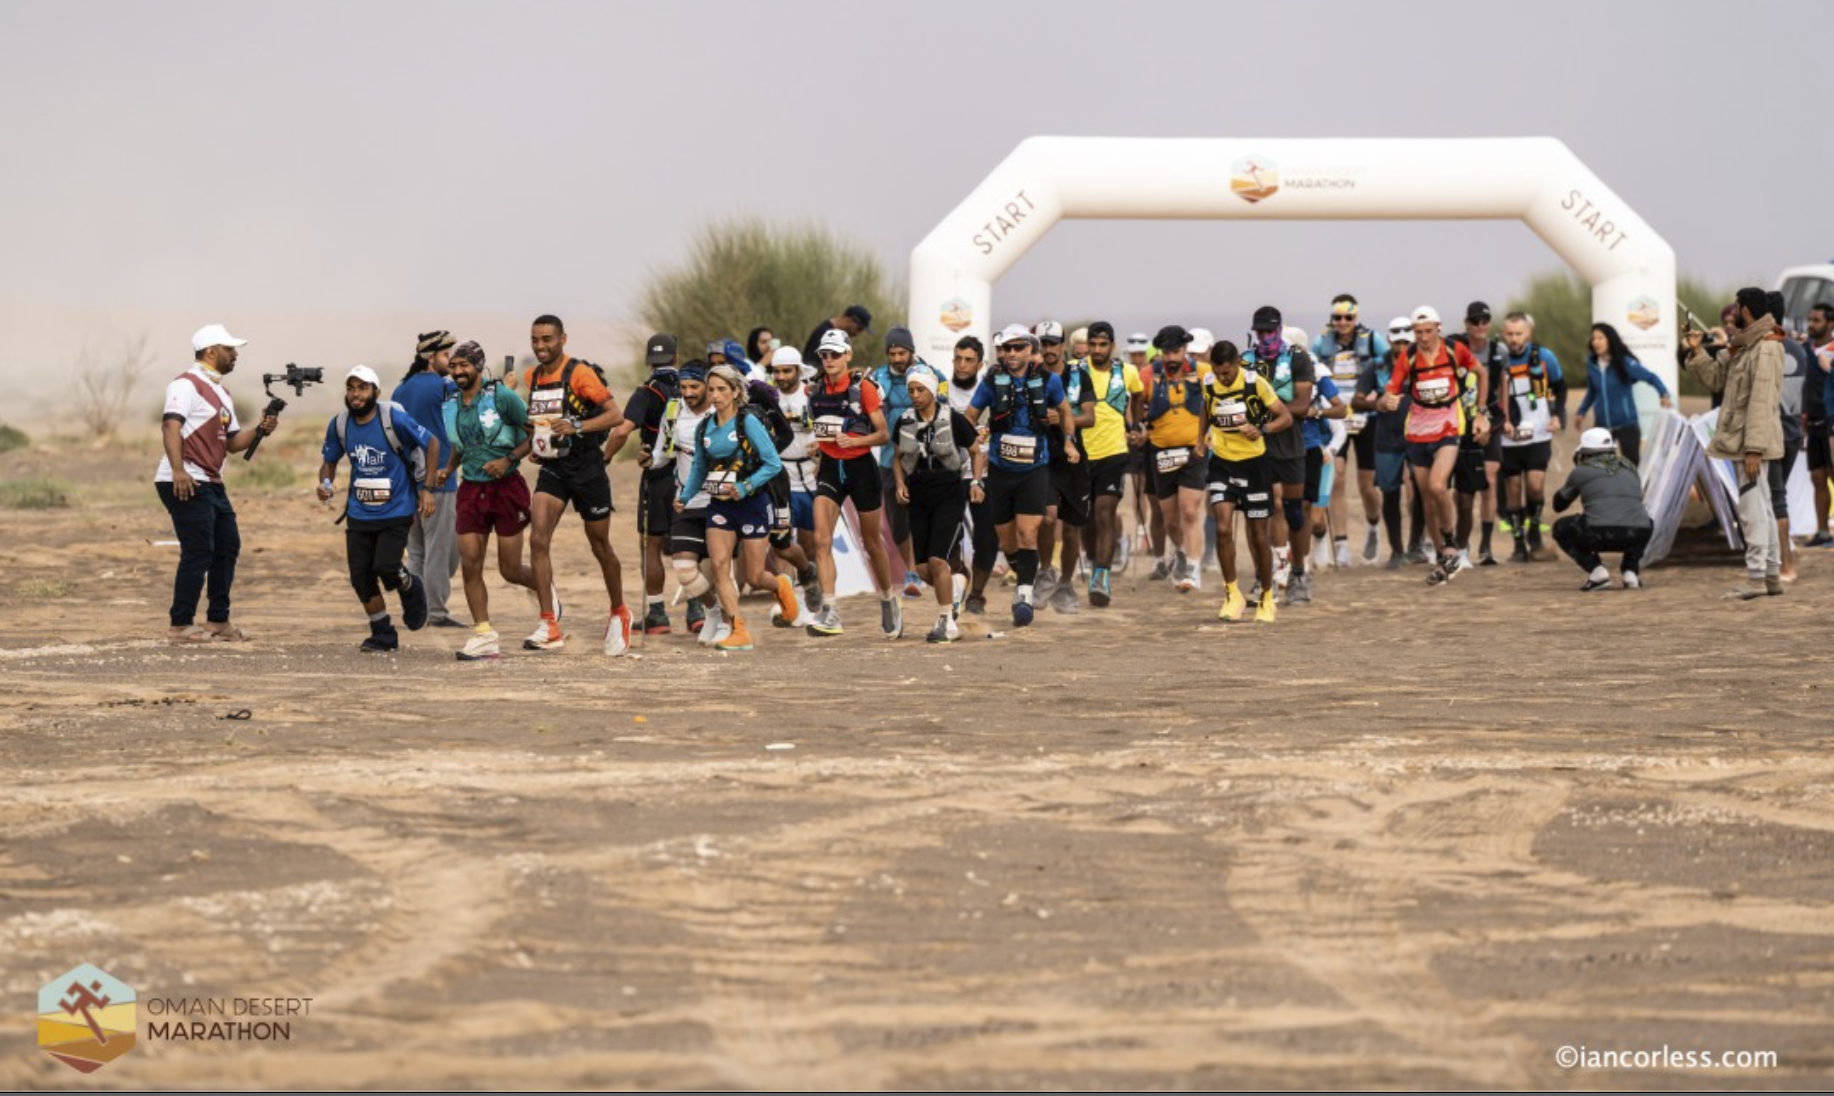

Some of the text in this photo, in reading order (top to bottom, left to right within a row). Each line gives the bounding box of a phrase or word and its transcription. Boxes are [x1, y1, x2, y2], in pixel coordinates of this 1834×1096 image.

[1284, 178, 1355, 189] MARATHON
[973, 190, 1035, 255] START
[1561, 189, 1629, 251] START
